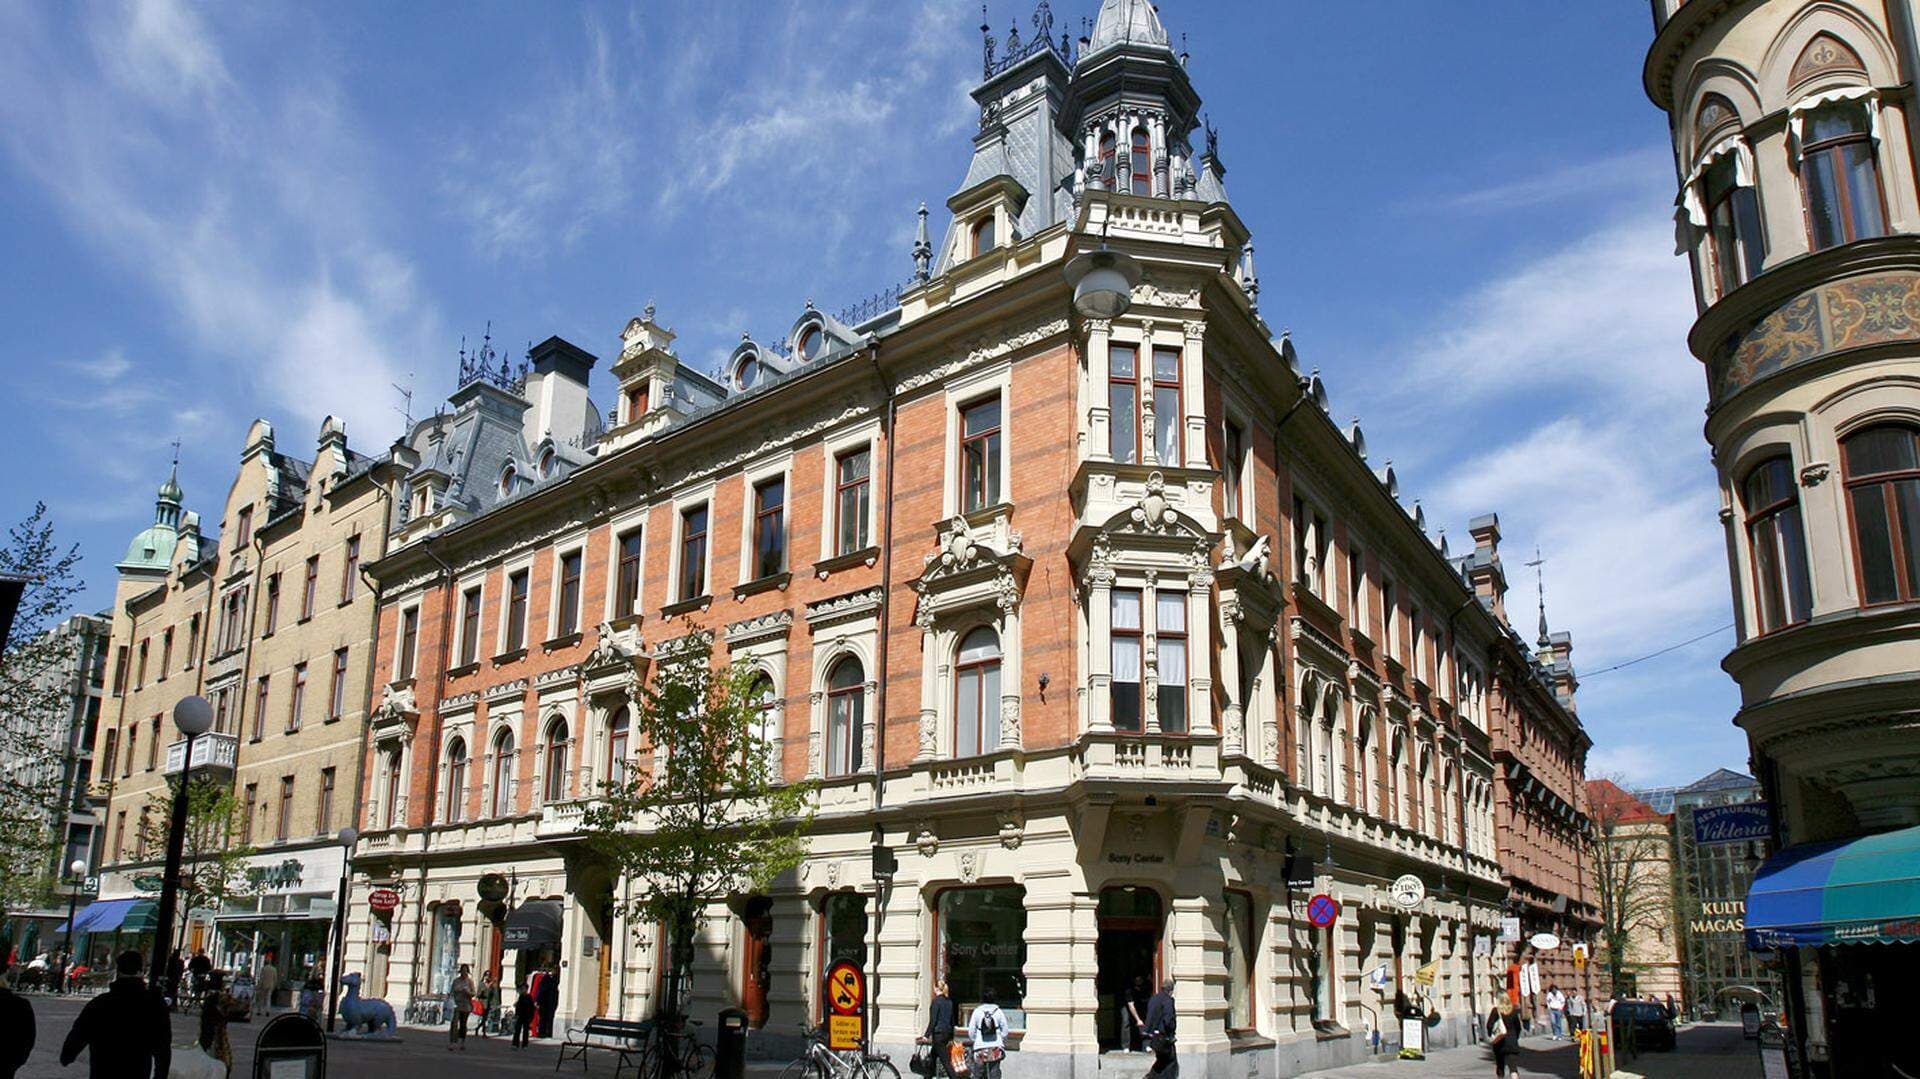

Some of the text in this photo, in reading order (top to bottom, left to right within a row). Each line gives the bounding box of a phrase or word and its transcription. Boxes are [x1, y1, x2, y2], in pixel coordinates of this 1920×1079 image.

[1697, 805, 1768, 825] RESTAURANG
[1700, 820, 1769, 840] Viktoria
[1108, 852, 1165, 865] Sony Center
[1690, 918, 1745, 933] MAGAS
[951, 943, 1019, 958] Sony Center
